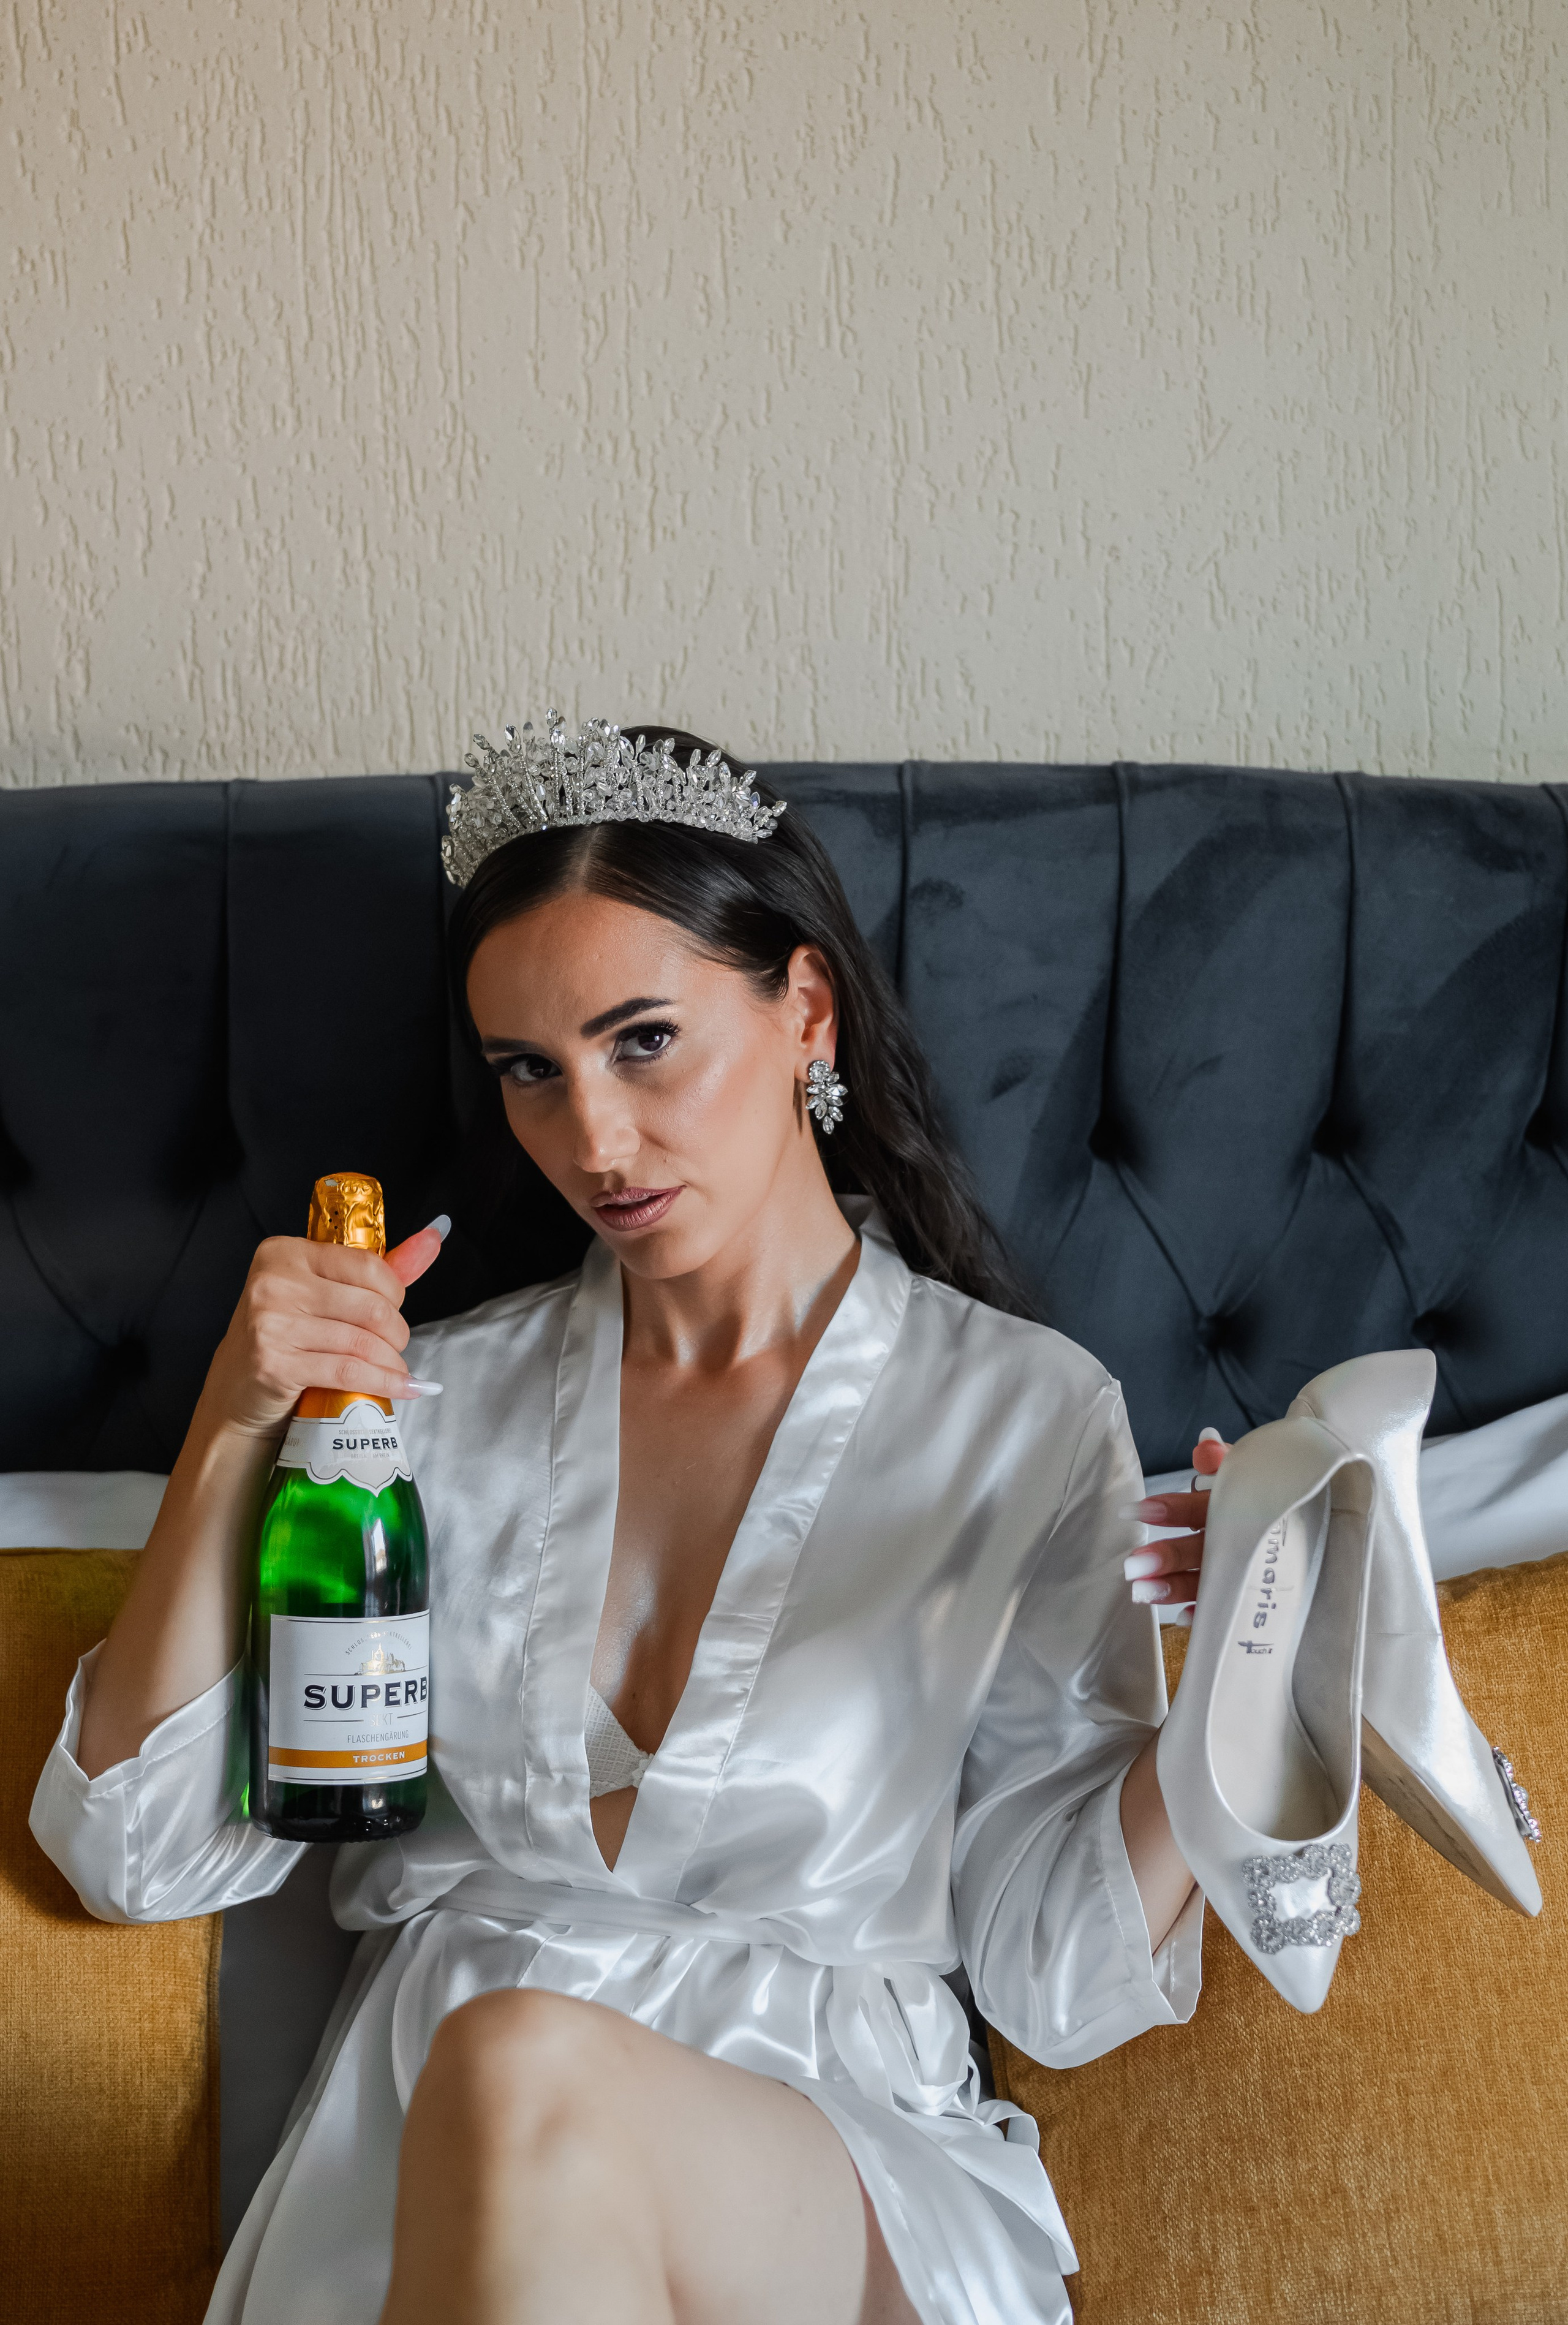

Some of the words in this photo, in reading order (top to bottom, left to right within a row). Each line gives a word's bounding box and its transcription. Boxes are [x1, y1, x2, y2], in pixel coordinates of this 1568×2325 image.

[332, 1437, 399, 1450] SUPERB
[303, 1676, 428, 1711] SUPERB
[371, 1712, 393, 1727] SEKT
[347, 1730, 409, 1743] FLASCHENGÄRUNG
[353, 1751, 405, 1763] TROCKEN
